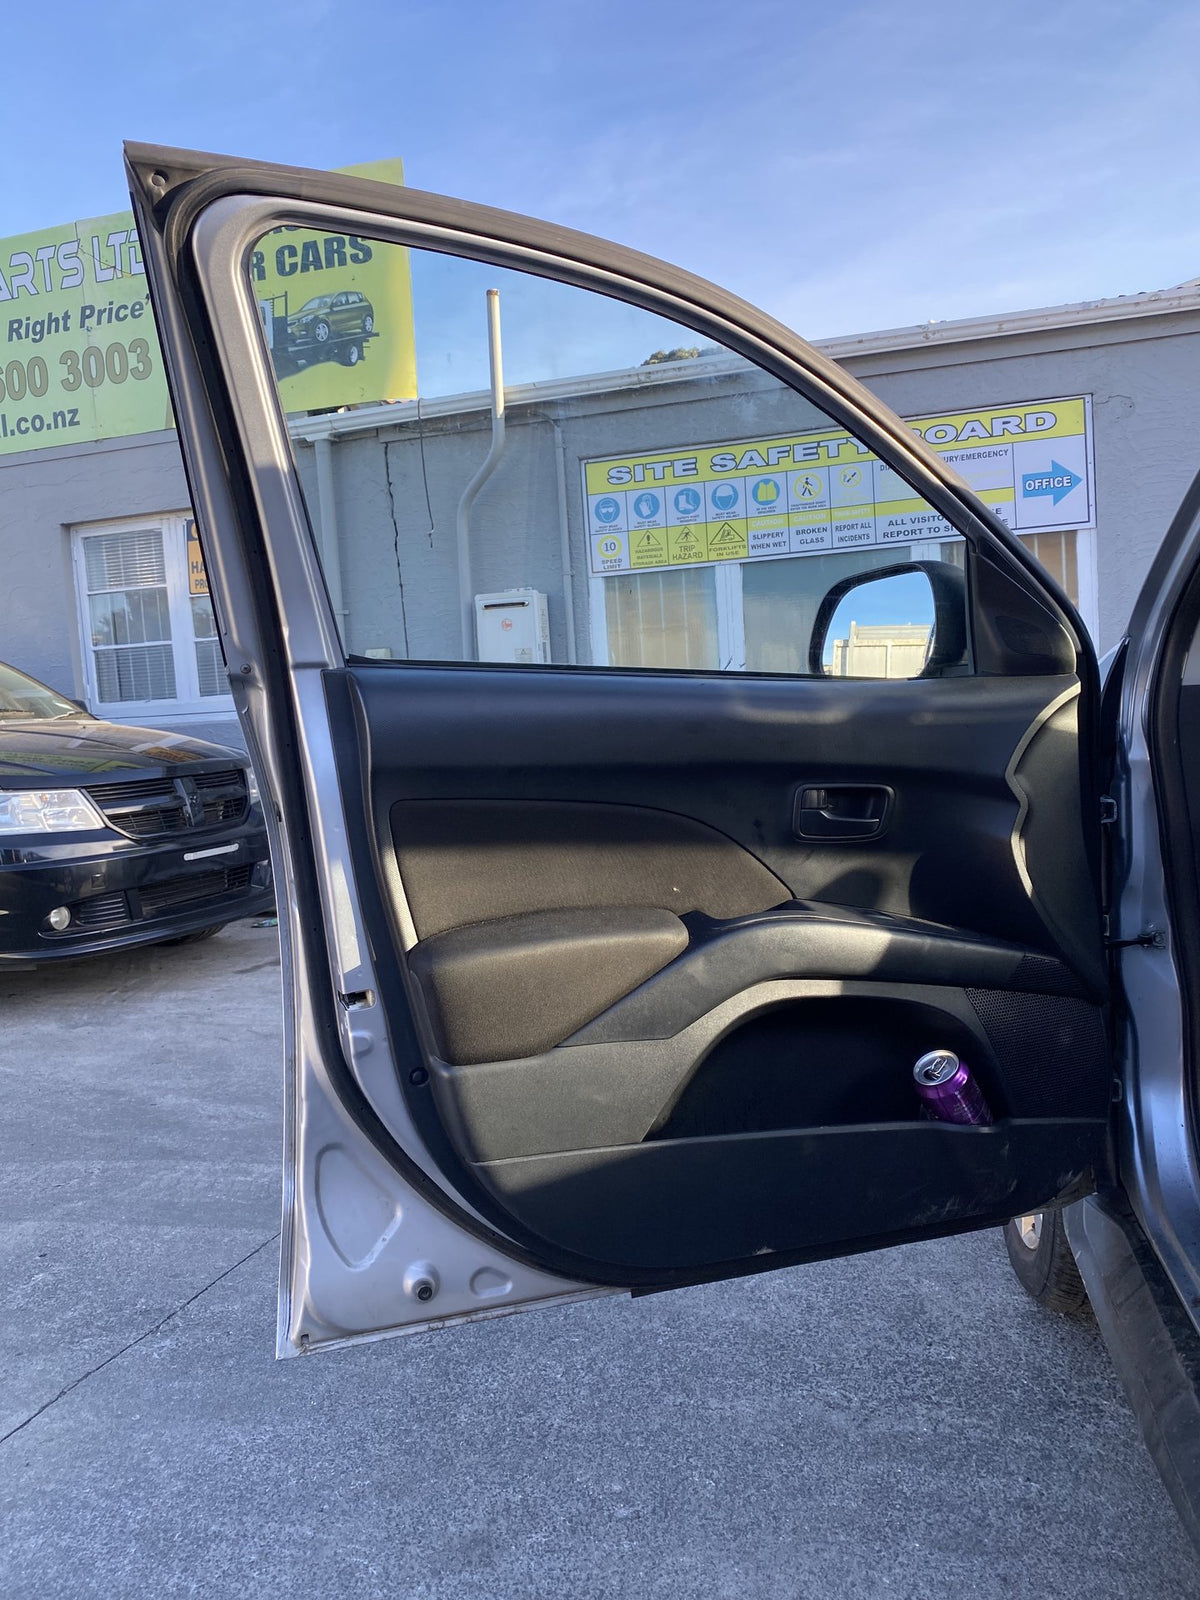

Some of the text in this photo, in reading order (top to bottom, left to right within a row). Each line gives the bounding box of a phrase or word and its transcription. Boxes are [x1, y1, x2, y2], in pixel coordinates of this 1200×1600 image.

[275, 235, 373, 277] CARS
[7, 309, 71, 343] Right
[59, 338, 153, 392] 3003
[606, 457, 698, 486] SITE
[709, 438, 870, 473] SAFETY
[1025, 475, 1072, 491] OFFICE
[835, 521, 872, 532] REPORT ALL
[888, 518, 907, 527] ALL
[752, 531, 784, 541] SLIPPERY
[795, 526, 828, 536] BROKEN
[882, 528, 924, 539] REPORT
[926, 526, 941, 534] TO
[799, 537, 825, 545] GLASS
[837, 532, 871, 543] INCIDENTS
[603, 541, 617, 552] 10
[679, 544, 696, 553] TRIP
[708, 544, 746, 552] FORKLIFTS
[750, 542, 771, 550] WHEN
[672, 551, 703, 561] HAZARD
